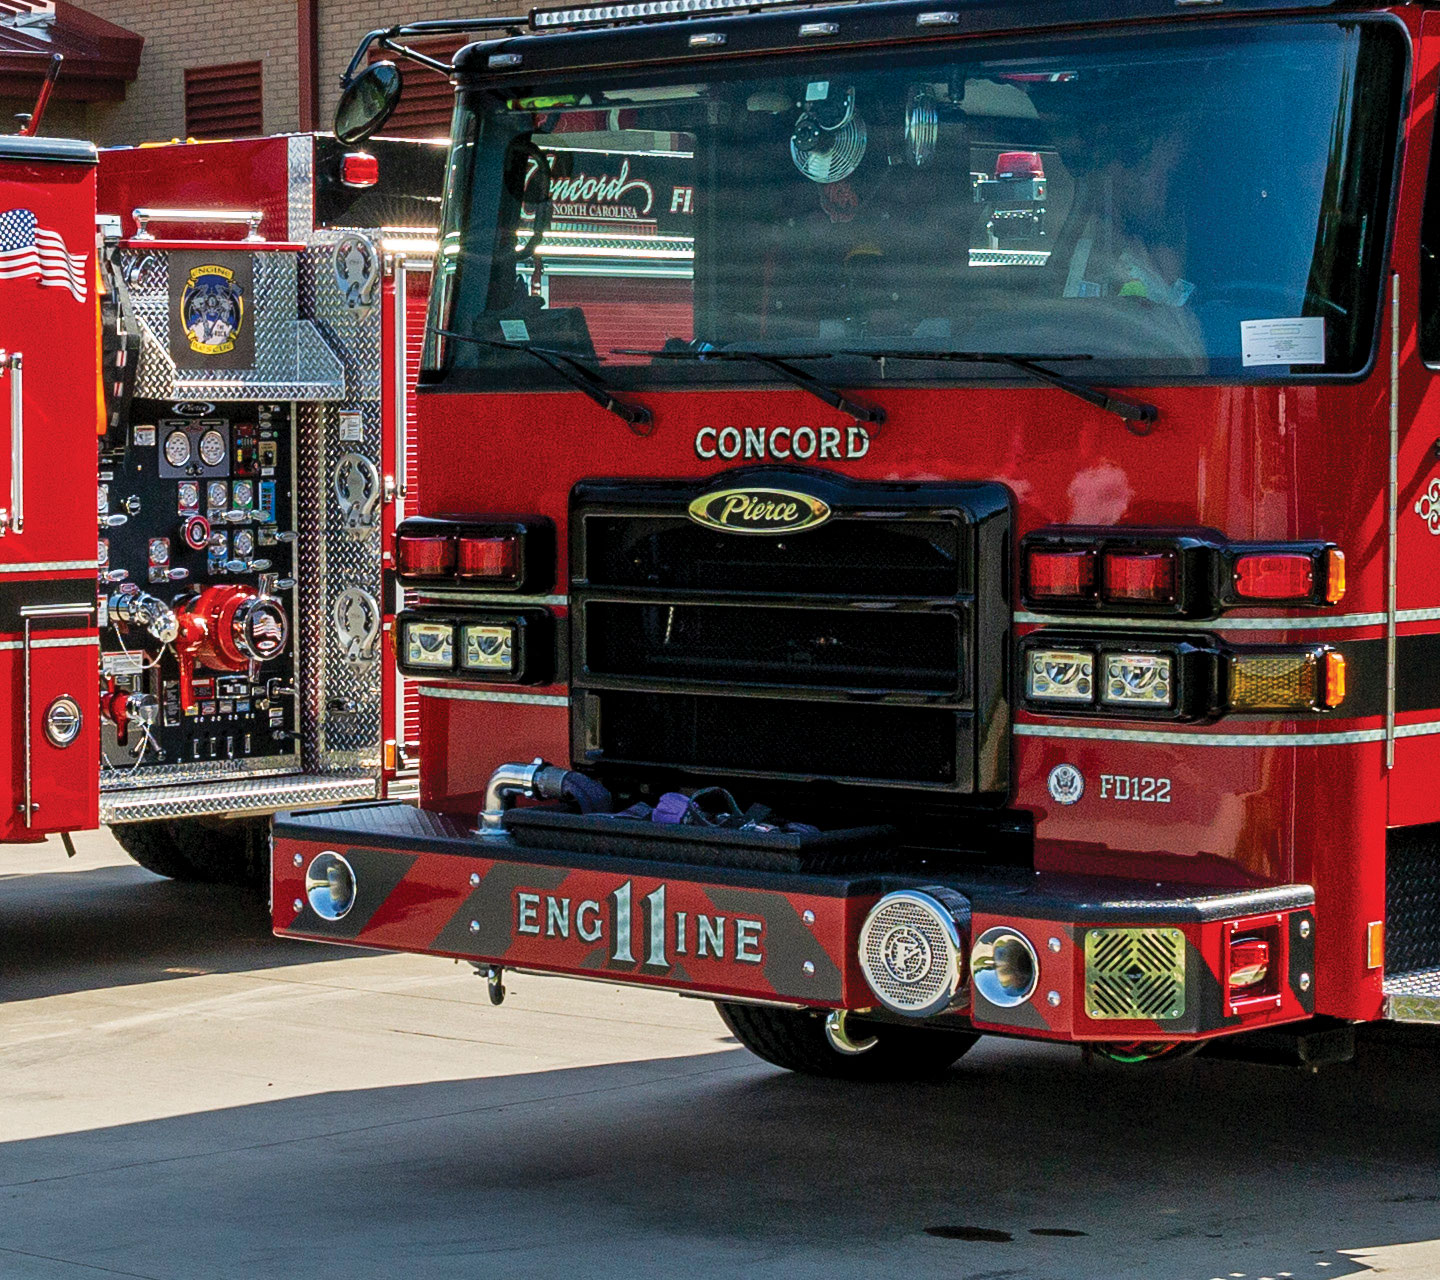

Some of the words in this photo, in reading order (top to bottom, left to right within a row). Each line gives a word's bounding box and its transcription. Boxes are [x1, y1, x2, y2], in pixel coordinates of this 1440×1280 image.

[552, 203, 587, 217] NORTH
[589, 203, 638, 219] CAROLINA
[695, 426, 869, 459] CONCORD
[721, 494, 799, 524] Pierce
[1100, 774, 1171, 802] FD122
